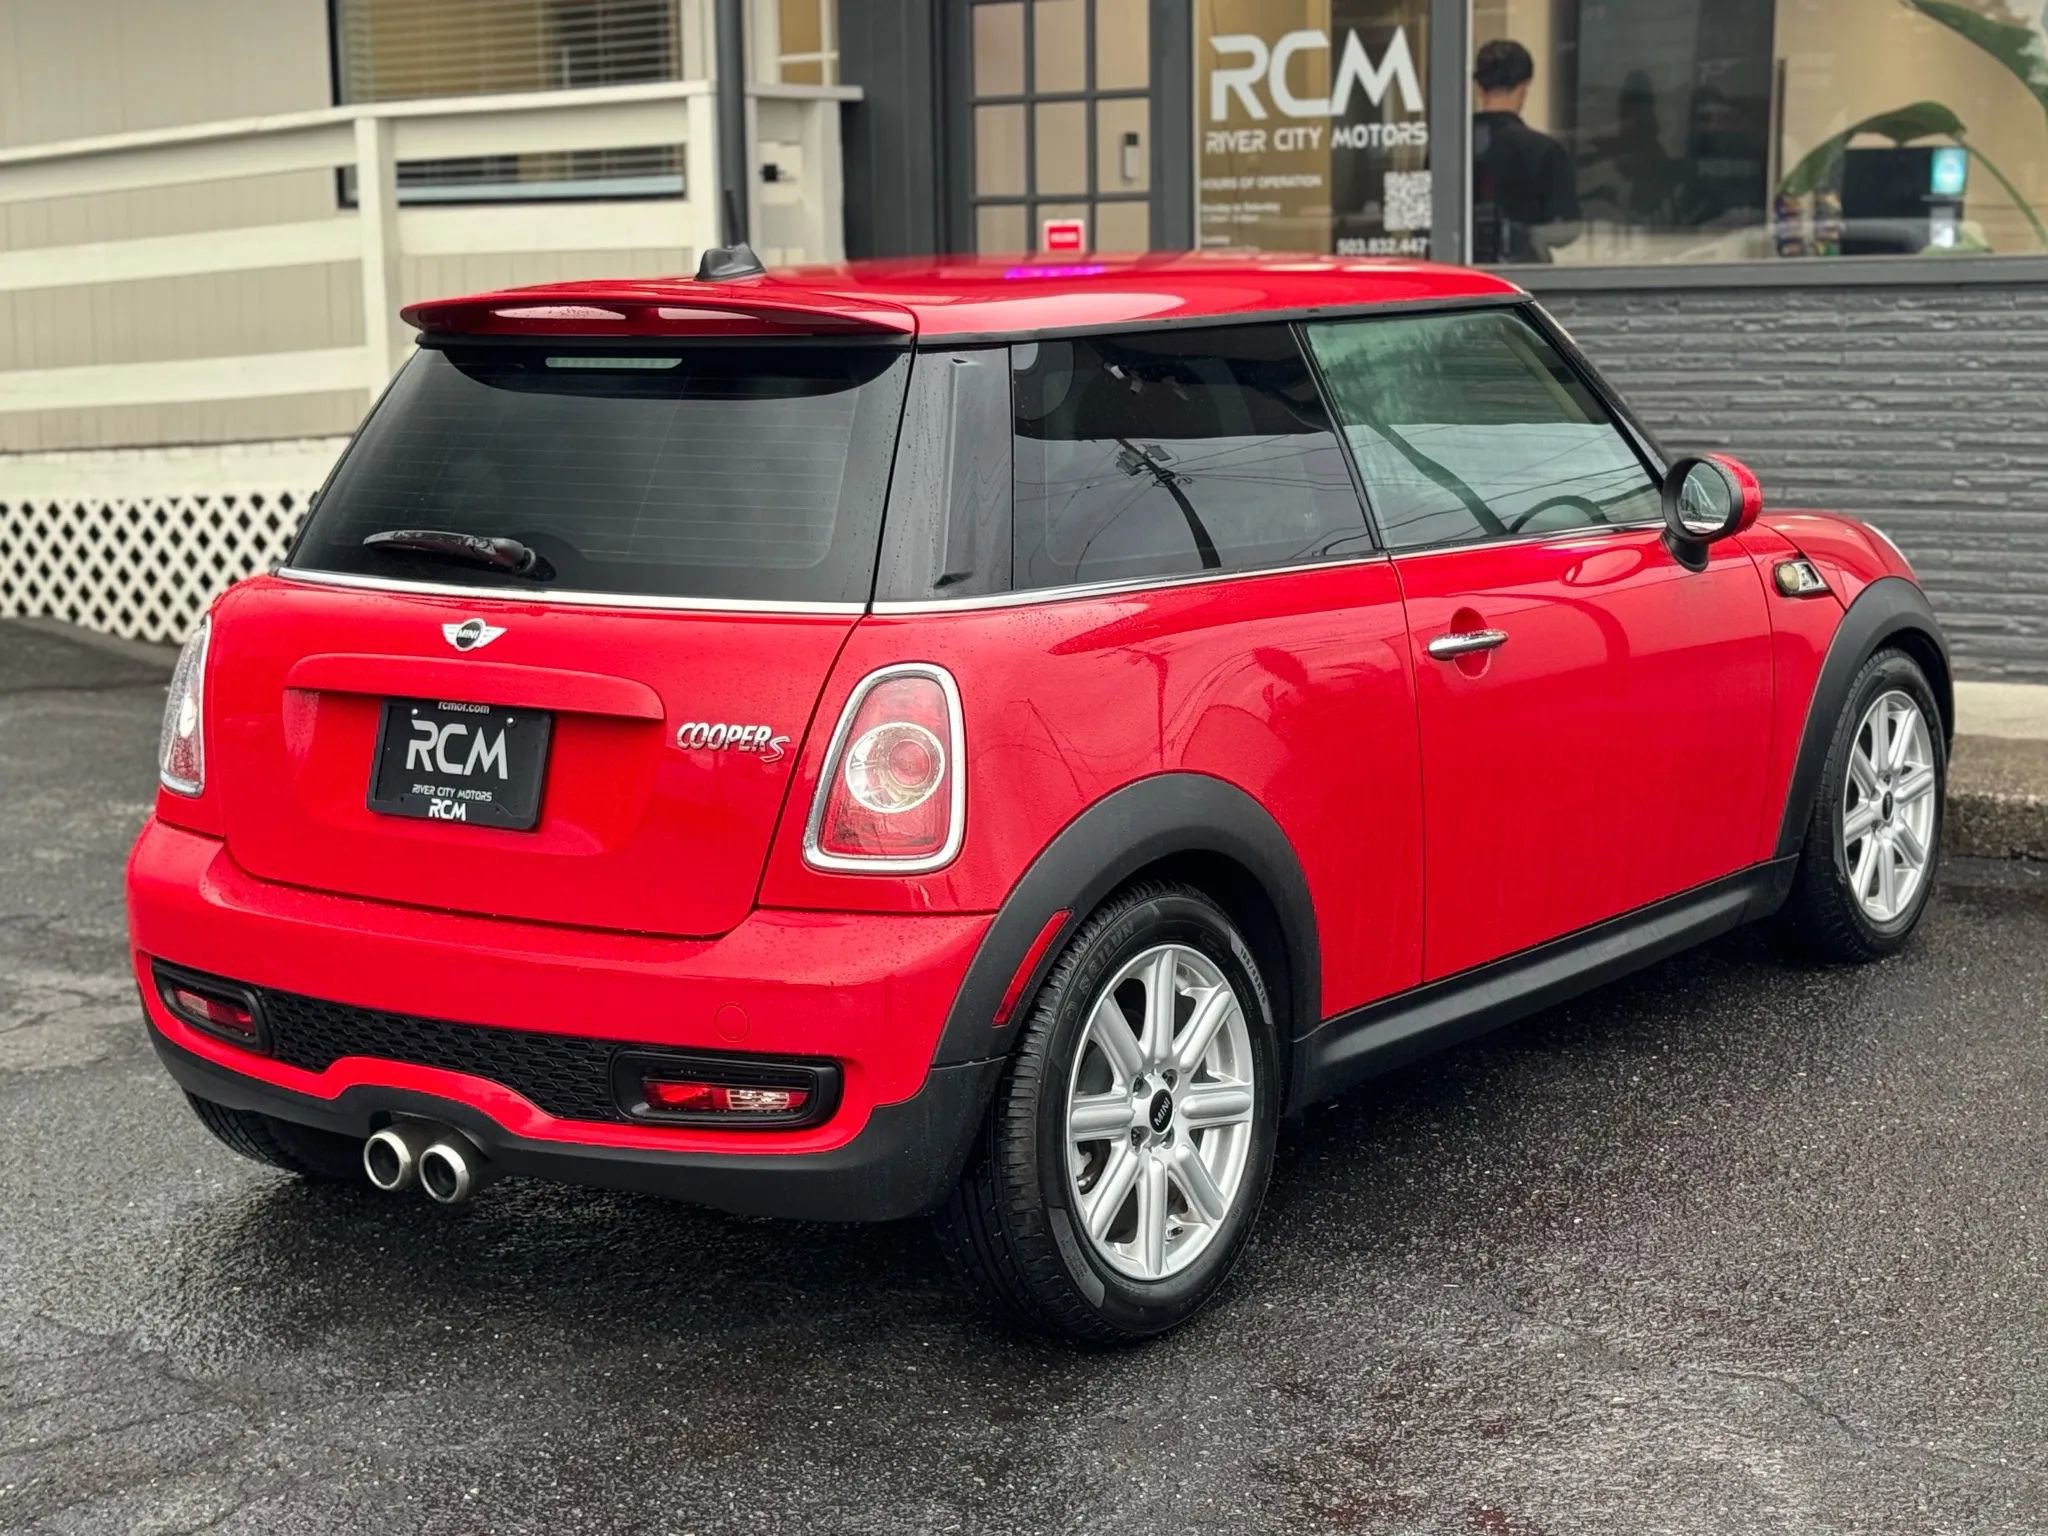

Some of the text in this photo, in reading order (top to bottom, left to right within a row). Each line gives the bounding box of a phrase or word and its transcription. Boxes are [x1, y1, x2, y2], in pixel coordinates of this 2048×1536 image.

[1209, 25, 1424, 122] RCM
[1205, 121, 1429, 155] RIVER CITY MOTORS
[1257, 174, 1323, 189] OPERATION
[457, 629, 480, 640] MINI
[405, 719, 509, 780] RCM
[676, 722, 791, 763] COOPER S
[411, 783, 493, 802] RIVER CITY MOTORS
[428, 798, 467, 821] RCM
[1154, 1096, 1171, 1126] MINI
